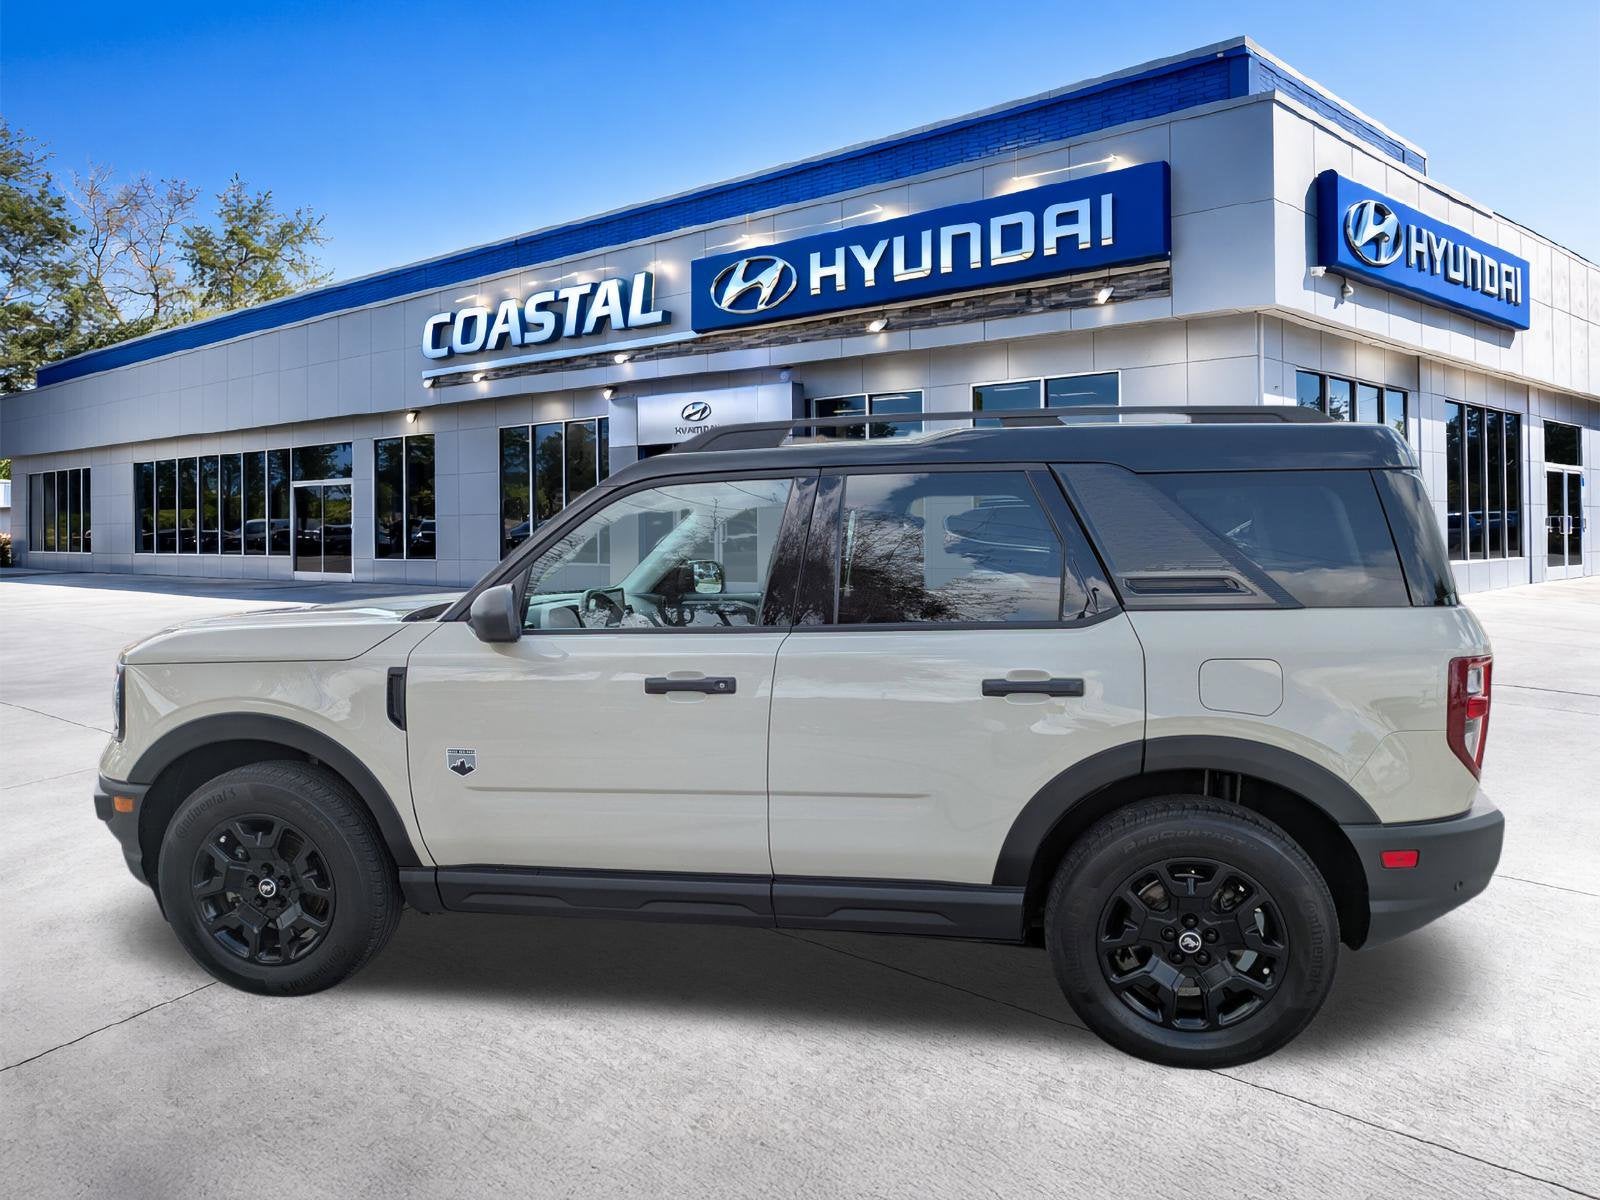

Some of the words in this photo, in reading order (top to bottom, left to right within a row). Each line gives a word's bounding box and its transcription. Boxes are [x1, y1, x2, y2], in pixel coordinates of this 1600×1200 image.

[809, 193, 1113, 295] HYUNDAI
[1406, 224, 1522, 306] HYUNDAI
[422, 271, 670, 359] COASTAL
